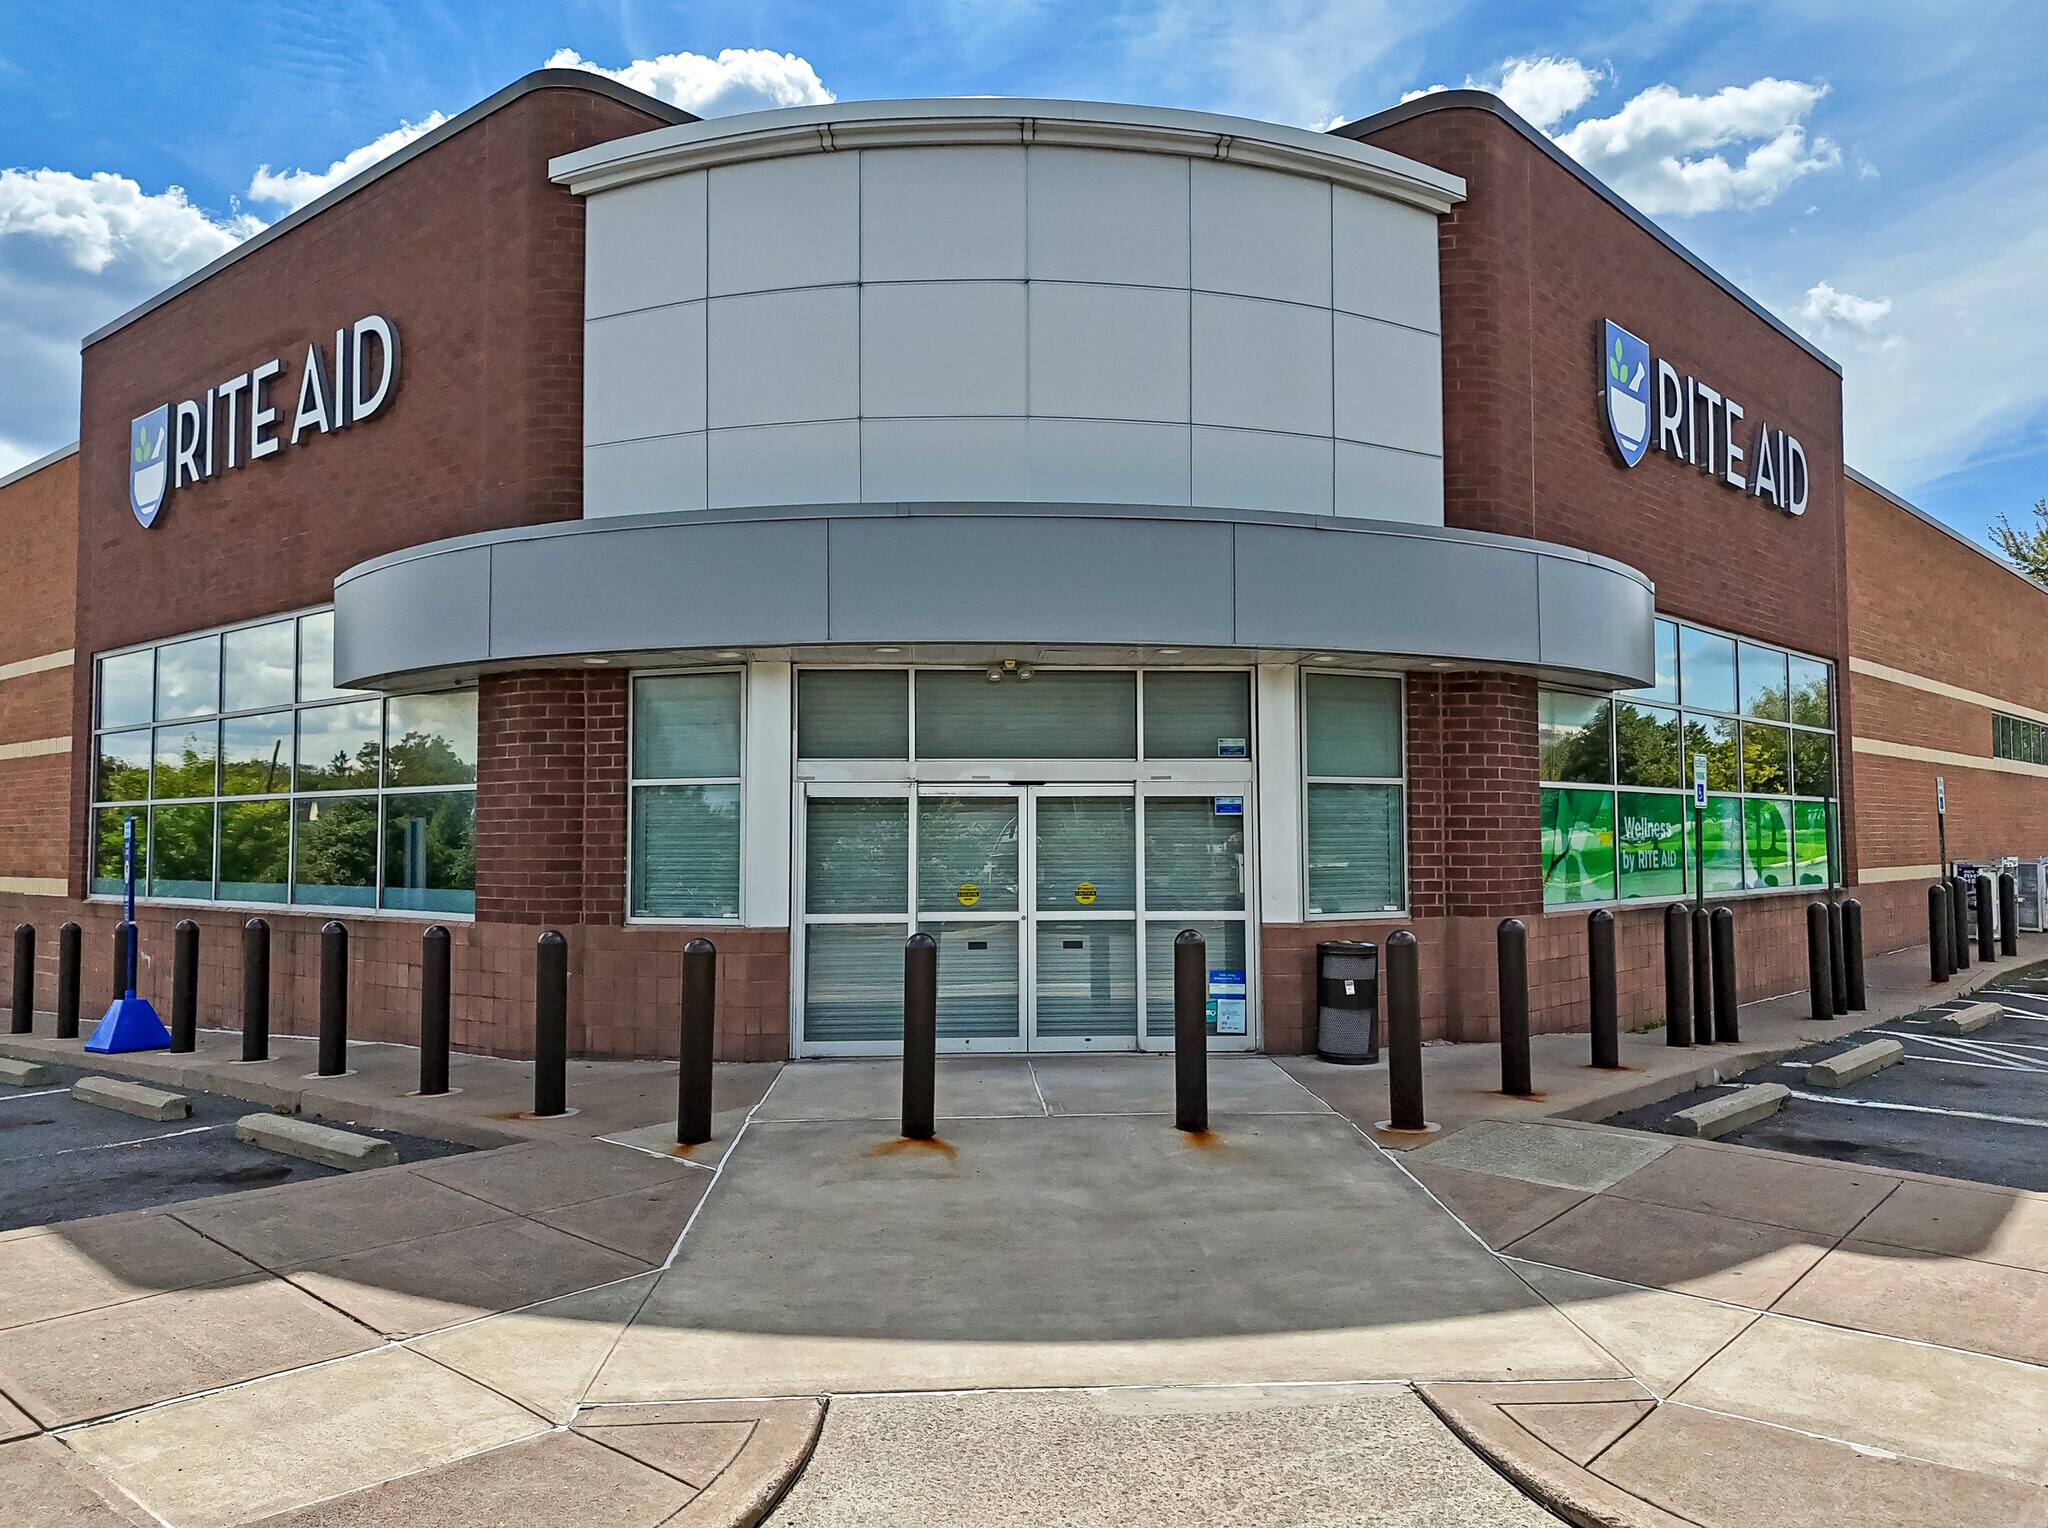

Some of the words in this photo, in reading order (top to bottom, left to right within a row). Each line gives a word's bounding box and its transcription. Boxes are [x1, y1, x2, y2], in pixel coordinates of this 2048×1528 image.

[175, 358, 280, 488] RITE
[291, 314, 394, 445] AID
[1658, 358, 1746, 490] RITE
[1755, 421, 1809, 516] AID
[1622, 850, 1635, 873] by
[1638, 850, 1660, 869] RITE
[1661, 850, 1677, 868] AID
[1623, 816, 1672, 838] Wellness
